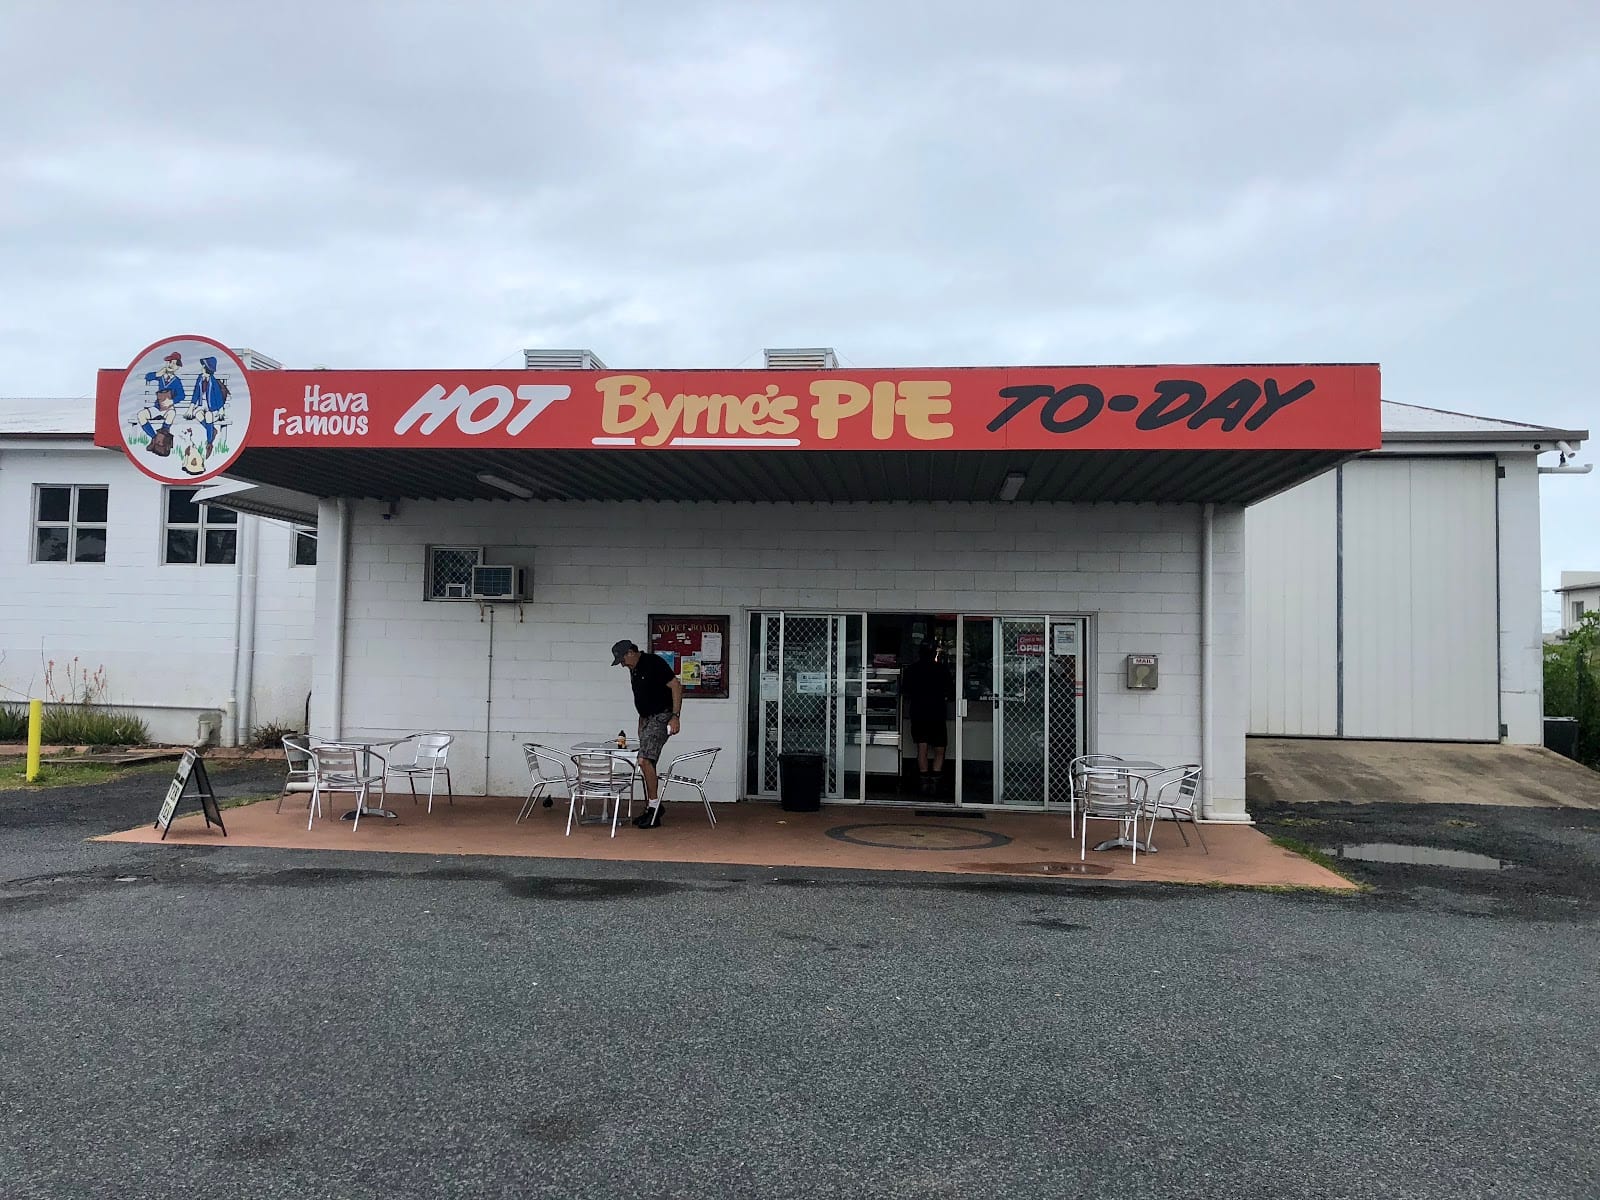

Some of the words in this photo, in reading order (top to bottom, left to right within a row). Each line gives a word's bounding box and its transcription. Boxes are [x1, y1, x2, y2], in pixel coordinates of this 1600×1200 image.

[304, 384, 369, 414] Hava
[394, 384, 571, 436] HOT
[595, 375, 800, 447] Byrne's
[810, 380, 954, 441] PIE
[986, 379, 1316, 434] TO-DAY
[272, 407, 369, 436] Famous
[658, 623, 688, 633] NOTICE
[690, 623, 720, 633] BOARD
